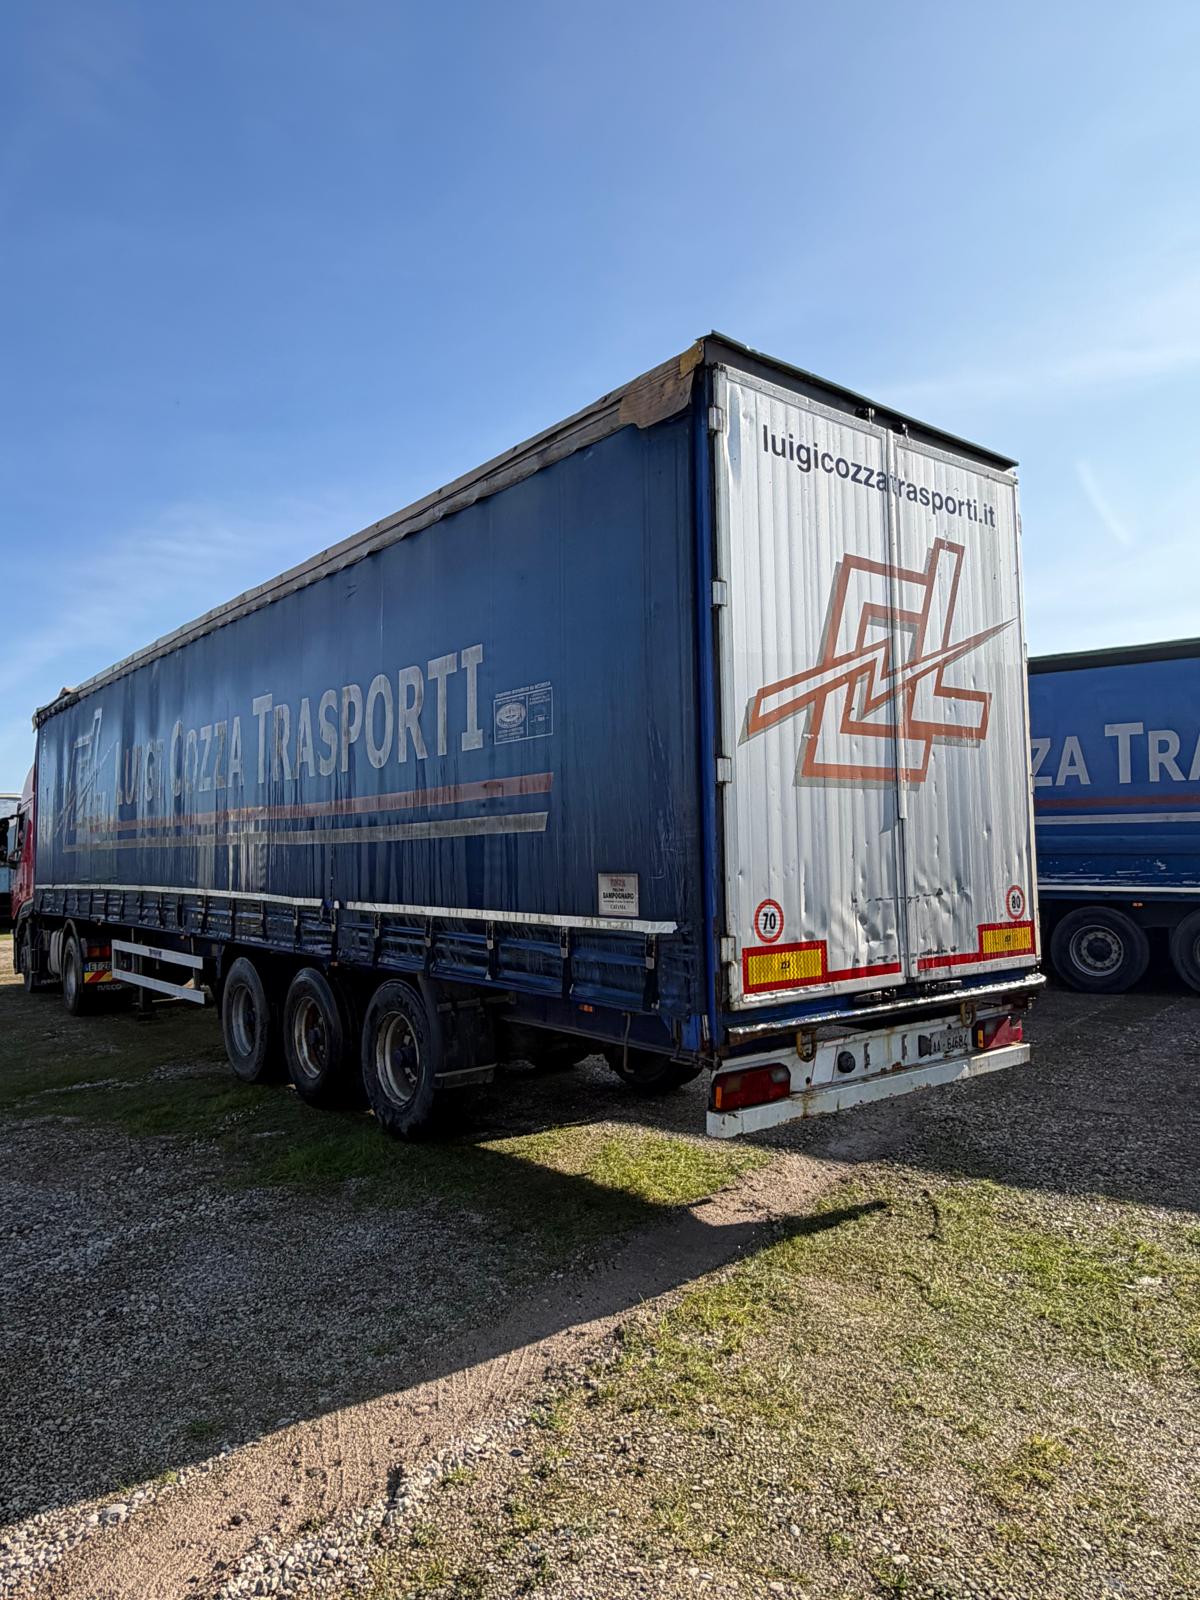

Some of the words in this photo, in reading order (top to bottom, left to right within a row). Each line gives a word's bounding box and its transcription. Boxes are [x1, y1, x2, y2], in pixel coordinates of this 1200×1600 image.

[762, 424, 996, 528] luigicozzatrasporti.it
[169, 719, 245, 798] COZZA
[252, 643, 484, 785] TRASPORTI
[762, 912, 777, 931] 70
[1011, 895, 1021, 909] 80
